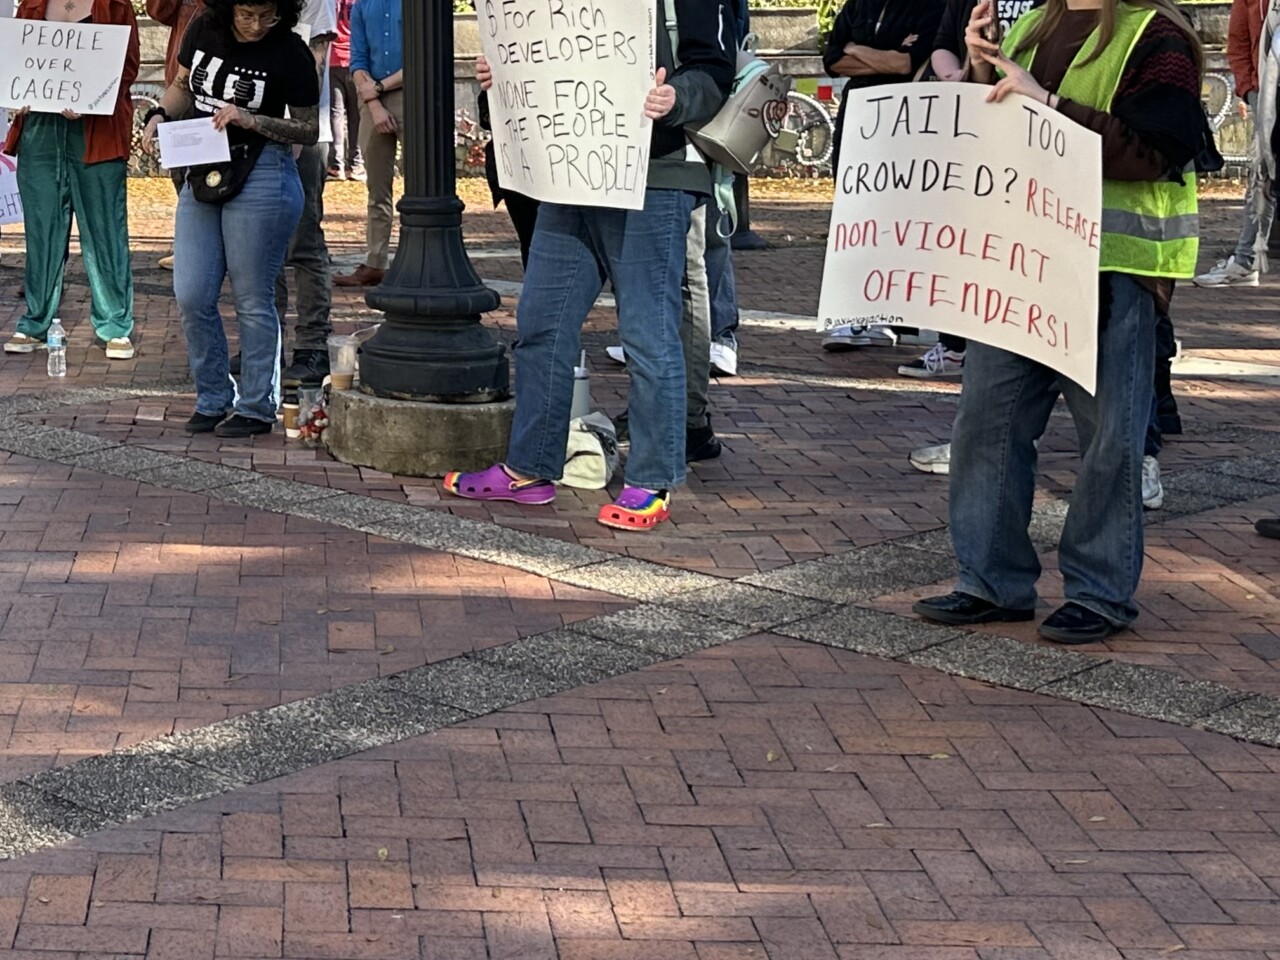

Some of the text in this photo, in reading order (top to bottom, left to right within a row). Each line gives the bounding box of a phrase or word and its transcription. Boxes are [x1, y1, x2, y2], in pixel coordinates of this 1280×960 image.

[502, 0, 536, 31] For
[21, 23, 104, 51] PEOPLE
[497, 30, 637, 65] DEVELOPERS
[24, 57, 76, 72] OVER
[10, 76, 82, 103] CAGES
[498, 80, 614, 110] NONE FOR
[505, 109, 629, 142] THE PEOPLE
[860, 94, 1066, 157] JAIL TOO
[500, 143, 513, 178] IS
[520, 147, 534, 184] A
[842, 159, 1099, 249] CROWDED? RELEASE
